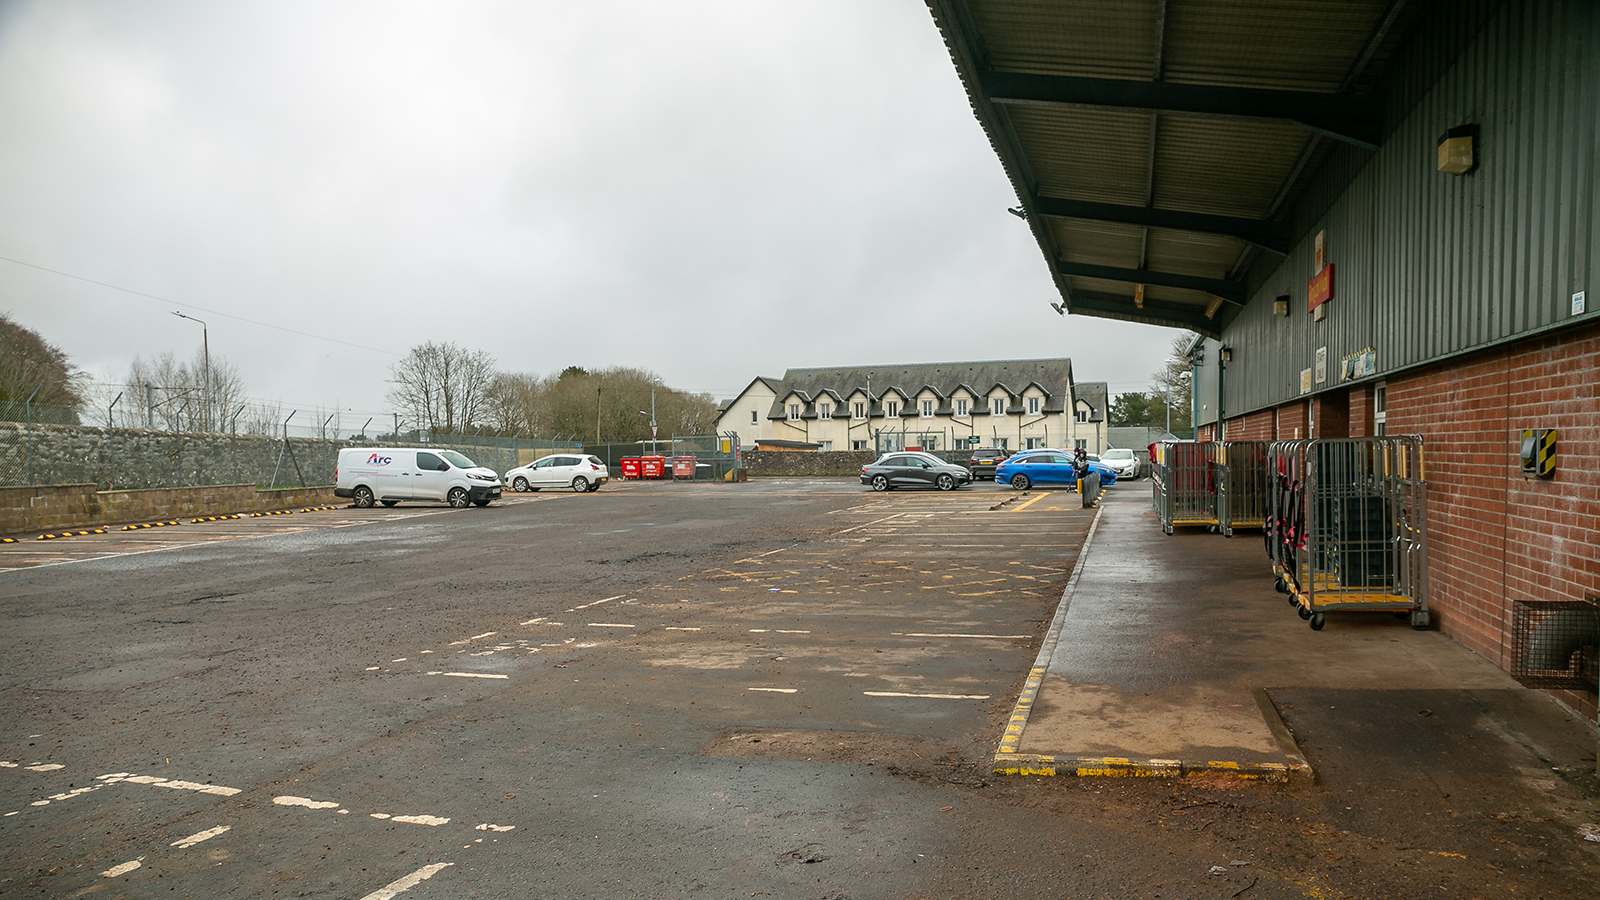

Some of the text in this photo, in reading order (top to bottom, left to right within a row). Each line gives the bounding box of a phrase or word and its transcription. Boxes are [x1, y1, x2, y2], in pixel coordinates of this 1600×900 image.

[1308, 270, 1329, 304] Royal Mail
[1316, 350, 1325, 364] STAFF
[366, 453, 392, 465] Arc
